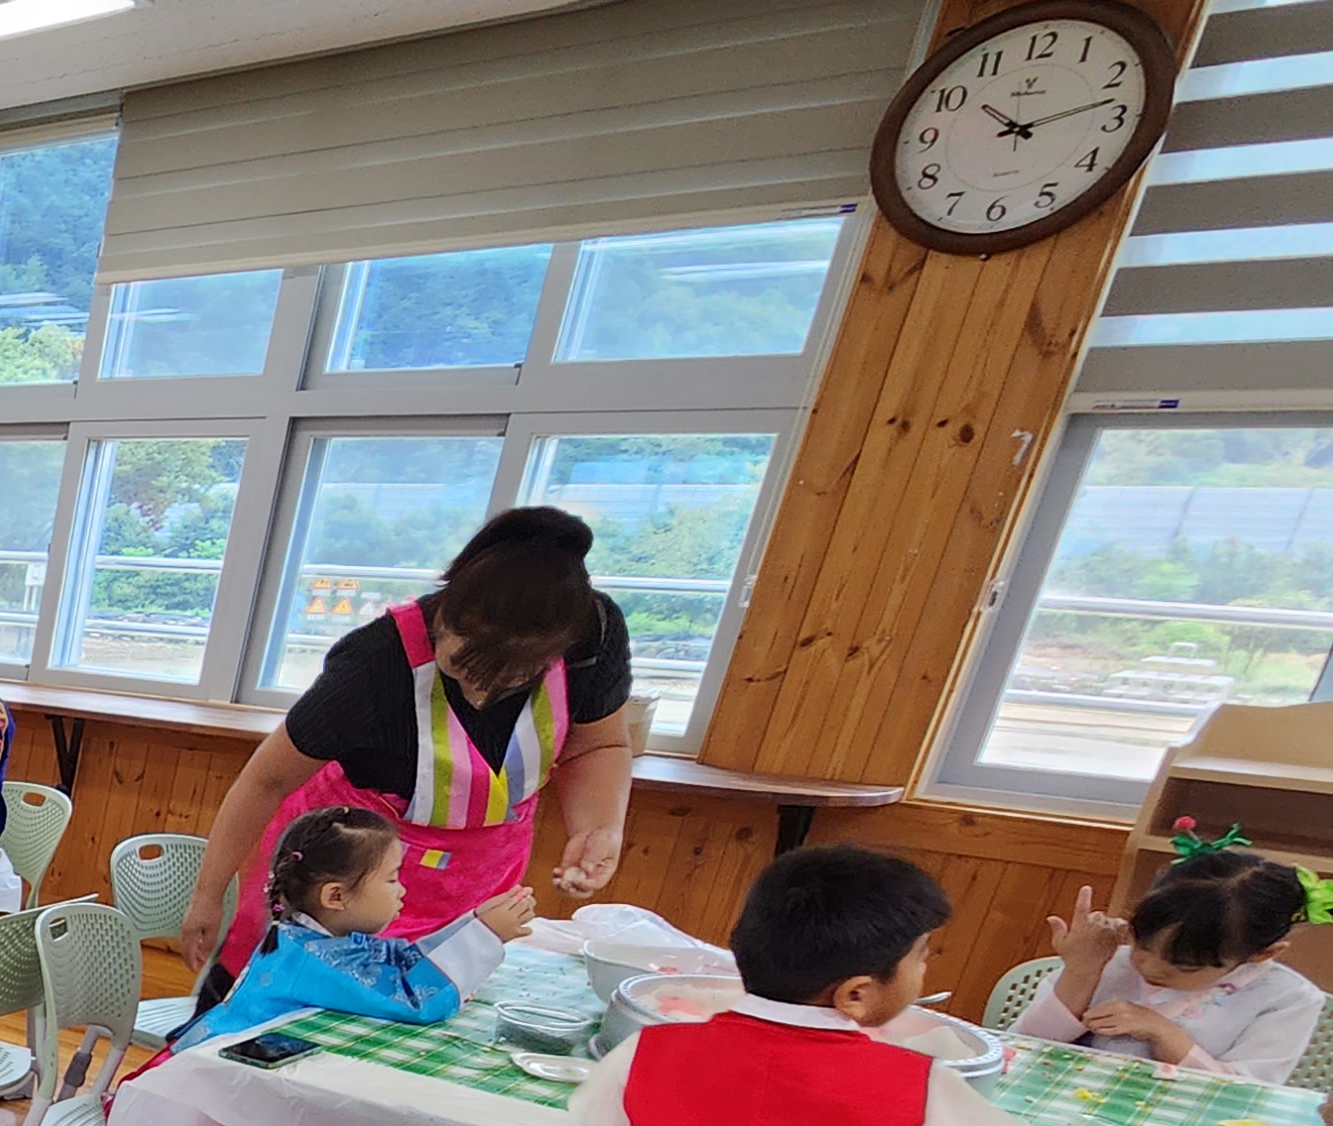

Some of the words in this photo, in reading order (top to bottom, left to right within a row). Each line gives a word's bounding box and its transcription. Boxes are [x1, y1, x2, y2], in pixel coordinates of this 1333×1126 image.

[1026, 32, 1058, 61] 12
[1079, 36, 1092, 62] 1
[977, 51, 1003, 77] 11
[1102, 61, 1127, 89] 2
[935, 86, 967, 112] 10
[1101, 105, 1127, 133] 3
[918, 128, 939, 152] 9
[1075, 147, 1099, 172] 4
[918, 164, 940, 189] 8
[946, 192, 965, 215] 7
[1035, 183, 1058, 208] 5
[986, 199, 1006, 222] 6
